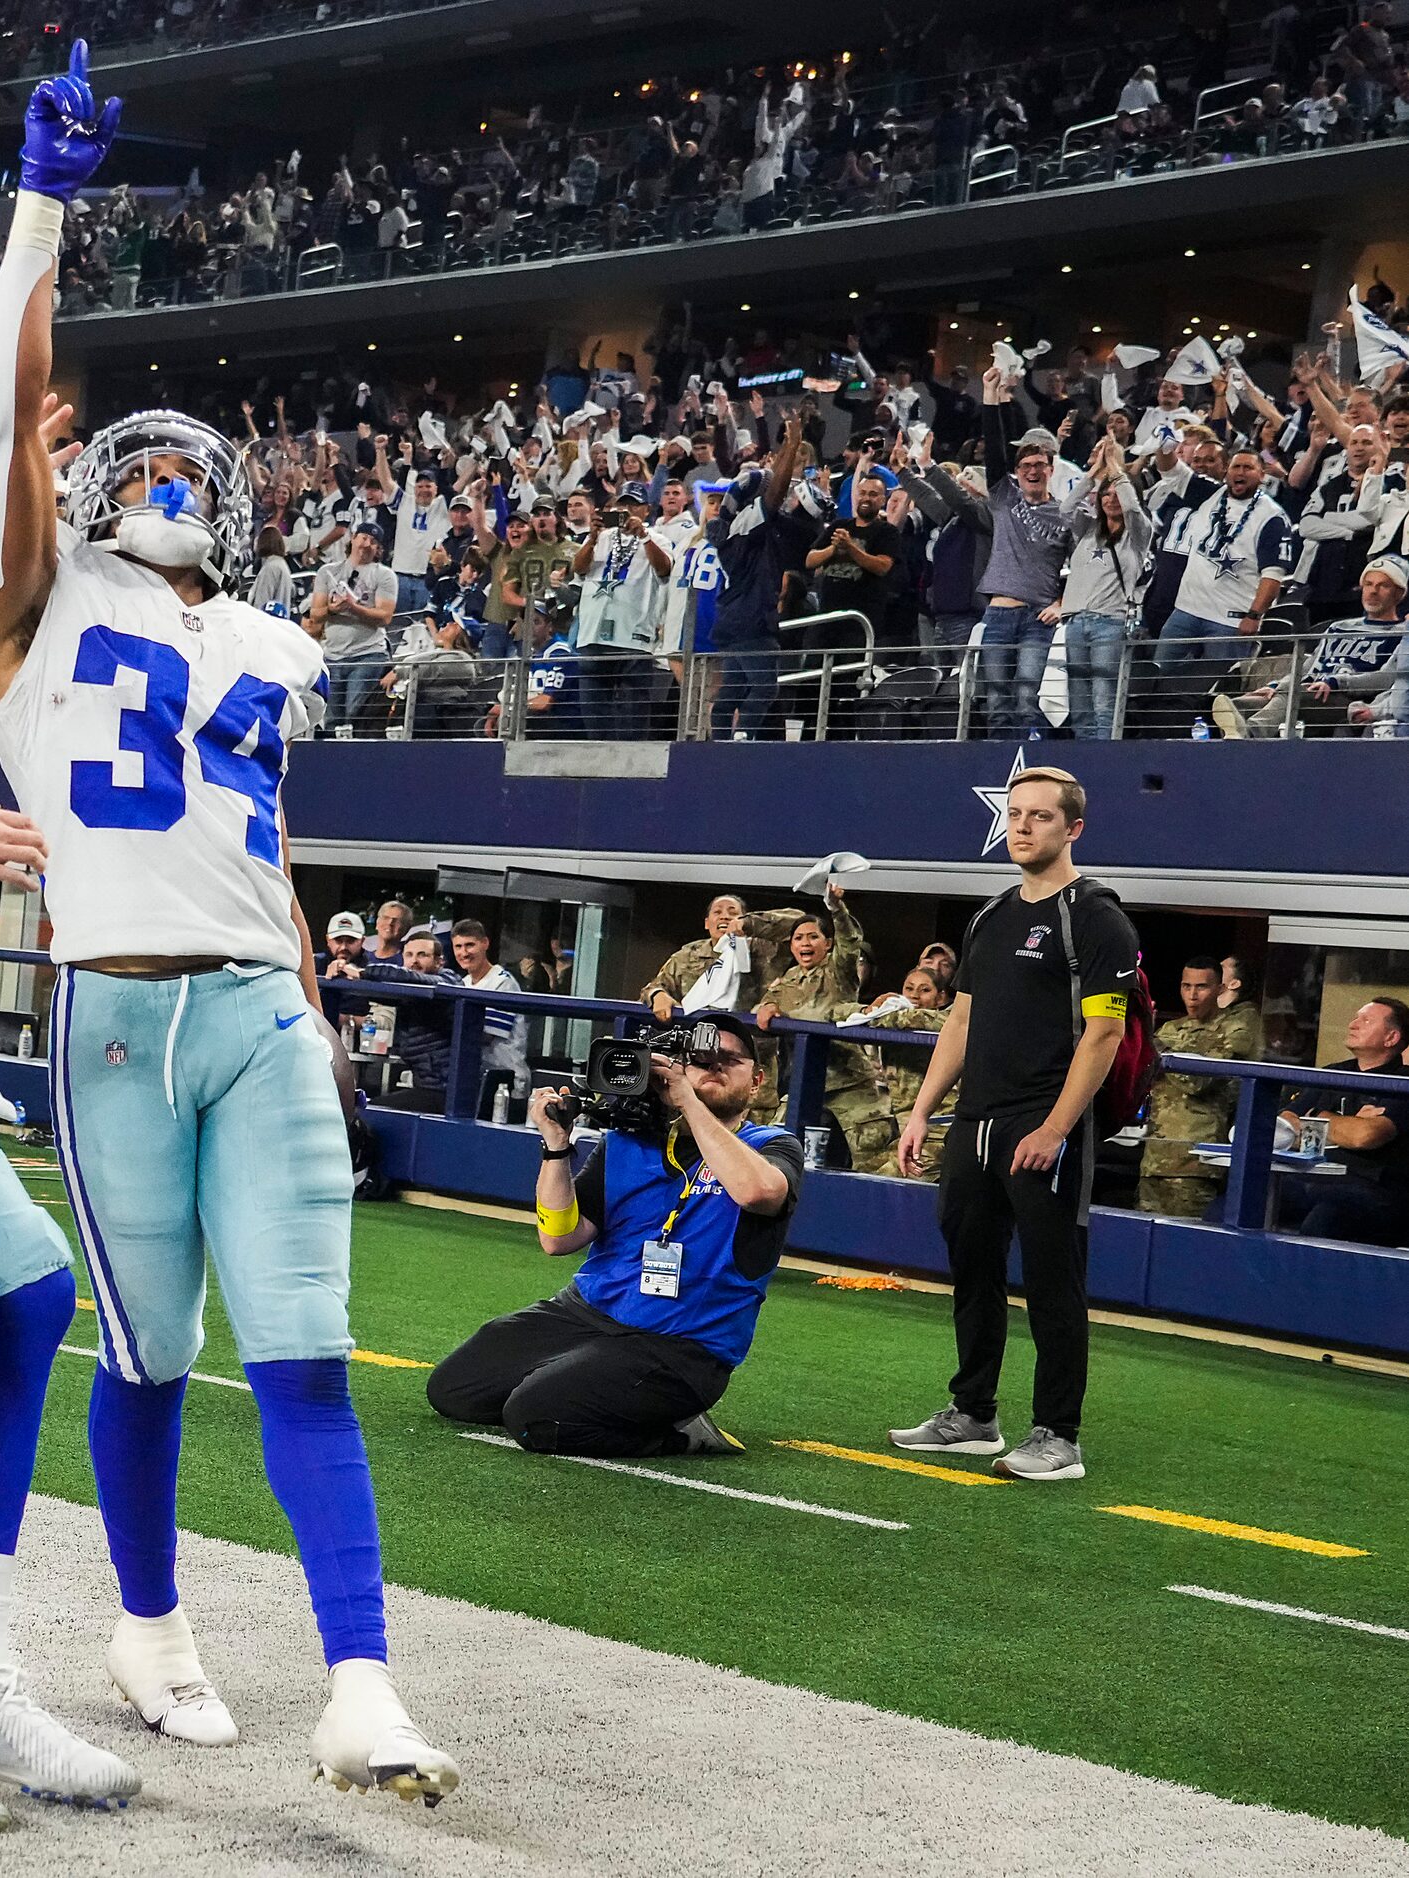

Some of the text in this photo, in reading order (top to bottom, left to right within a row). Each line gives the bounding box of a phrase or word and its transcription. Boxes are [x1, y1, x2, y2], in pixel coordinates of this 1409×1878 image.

[677, 546, 720, 591] 18
[544, 670, 565, 689] 28
[70, 624, 287, 871] 34
[1111, 996, 1126, 1006] WEE
[107, 1051, 124, 1064] NFL
[644, 1275, 651, 1283] 8
